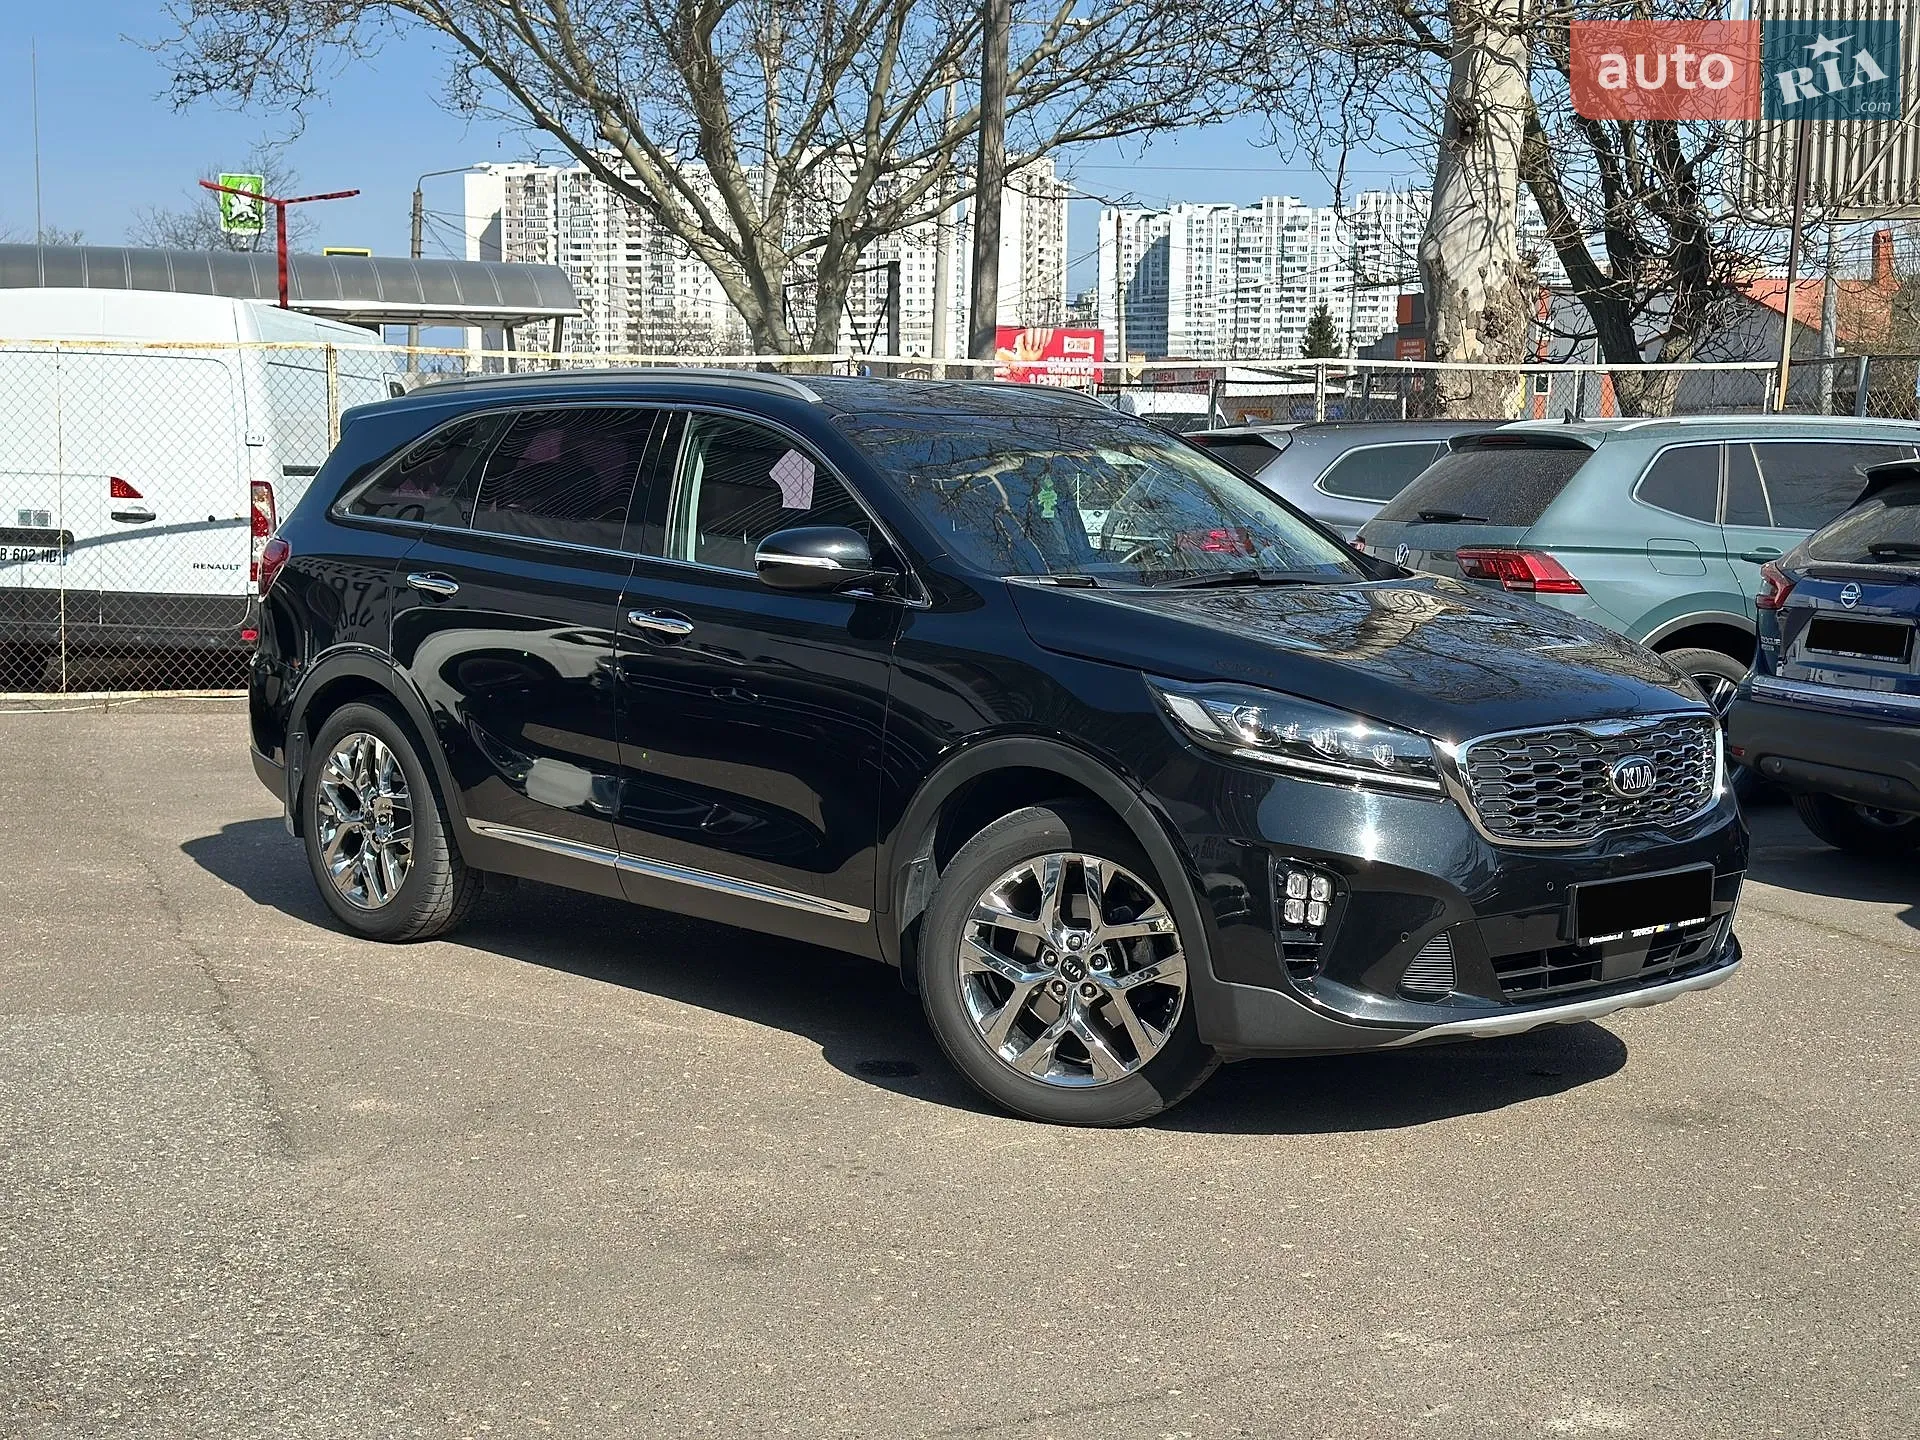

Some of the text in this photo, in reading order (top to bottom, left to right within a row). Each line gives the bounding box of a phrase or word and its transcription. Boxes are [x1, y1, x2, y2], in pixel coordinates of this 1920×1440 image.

[192, 562, 242, 571] RENAULT
[1621, 765, 1653, 790] KIA
[1063, 959, 1082, 979] KIA
